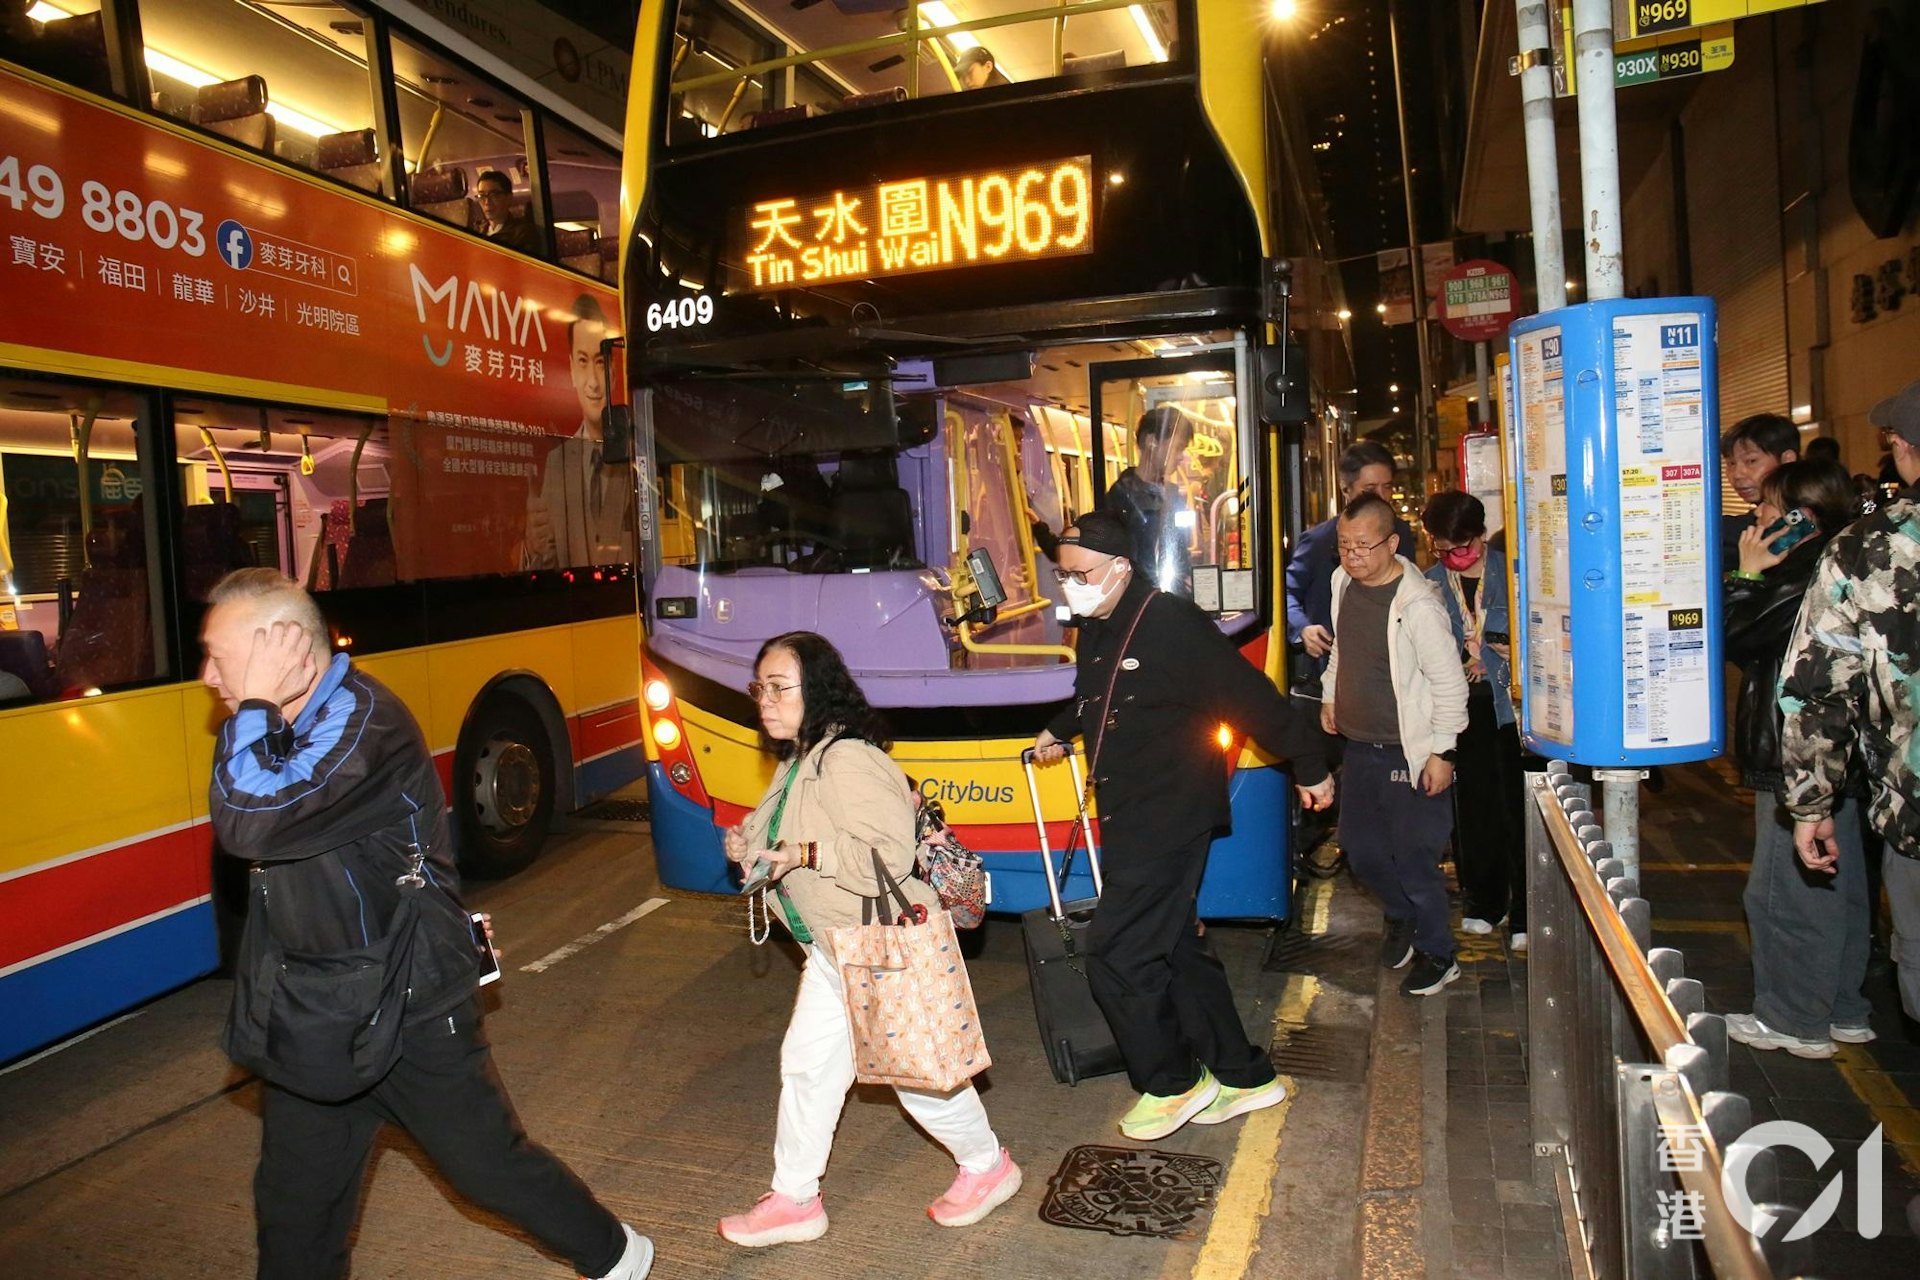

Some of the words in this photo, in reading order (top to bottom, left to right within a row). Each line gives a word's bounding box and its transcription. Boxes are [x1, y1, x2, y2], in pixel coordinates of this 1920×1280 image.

[1640, 0, 1688, 23] N969
[1616, 56, 1657, 78] 930X
[1661, 50, 1700, 70] N930
[0, 155, 65, 220] 49
[81, 180, 206, 257] 8803
[751, 180, 929, 254] 天水圍
[936, 163, 1090, 264] N969
[259, 241, 327, 280] 麥芽牙科
[746, 254, 795, 286] Tin
[800, 241, 868, 281] Shui
[876, 231, 939, 271] Wai
[9, 235, 66, 275] 寶安
[97, 255, 146, 291] 福田
[172, 272, 215, 305] 龍華
[239, 287, 276, 319] 沙井
[297, 302, 361, 336] 光明院區
[409, 262, 548, 353] MAIYA
[646, 294, 714, 333] 6409
[1667, 325, 1692, 345] N11
[464, 344, 545, 386] 麥芽牙科
[1665, 469, 1678, 477] 307
[1682, 467, 1700, 476] 307A
[1672, 612, 1699, 626] N969
[920, 778, 1014, 804] Citybus
[1390, 769, 1412, 782] GA
